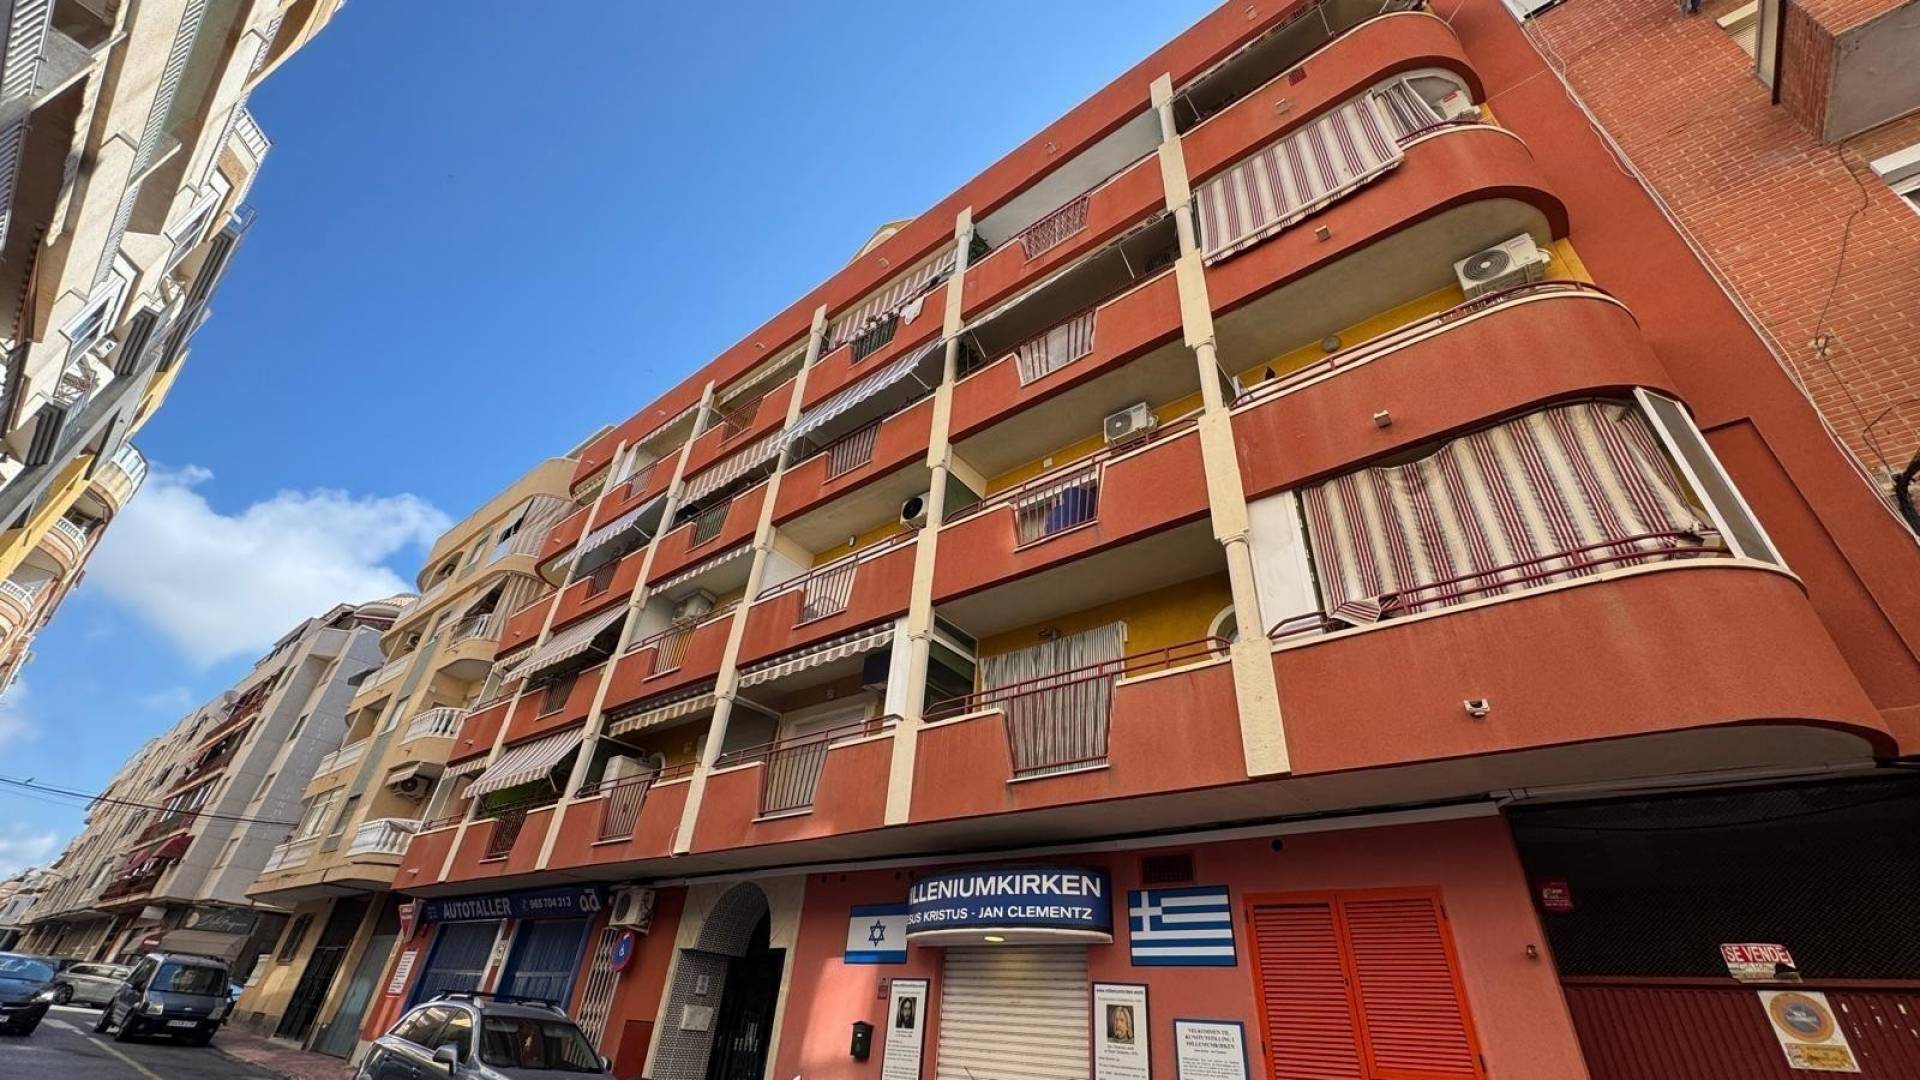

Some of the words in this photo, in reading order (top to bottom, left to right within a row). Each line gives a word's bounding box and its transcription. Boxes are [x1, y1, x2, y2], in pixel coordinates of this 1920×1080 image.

[908, 874, 1101, 905] ILLENIUMKIRKEN
[443, 897, 512, 919] AUTOTALLER
[923, 907, 968, 922] KRISTUS
[978, 906, 1003, 918] JAN
[1007, 905, 1093, 920] CLEMENTZ
[1724, 946, 1745, 962] SE
[1742, 946, 1789, 963] VENDE
